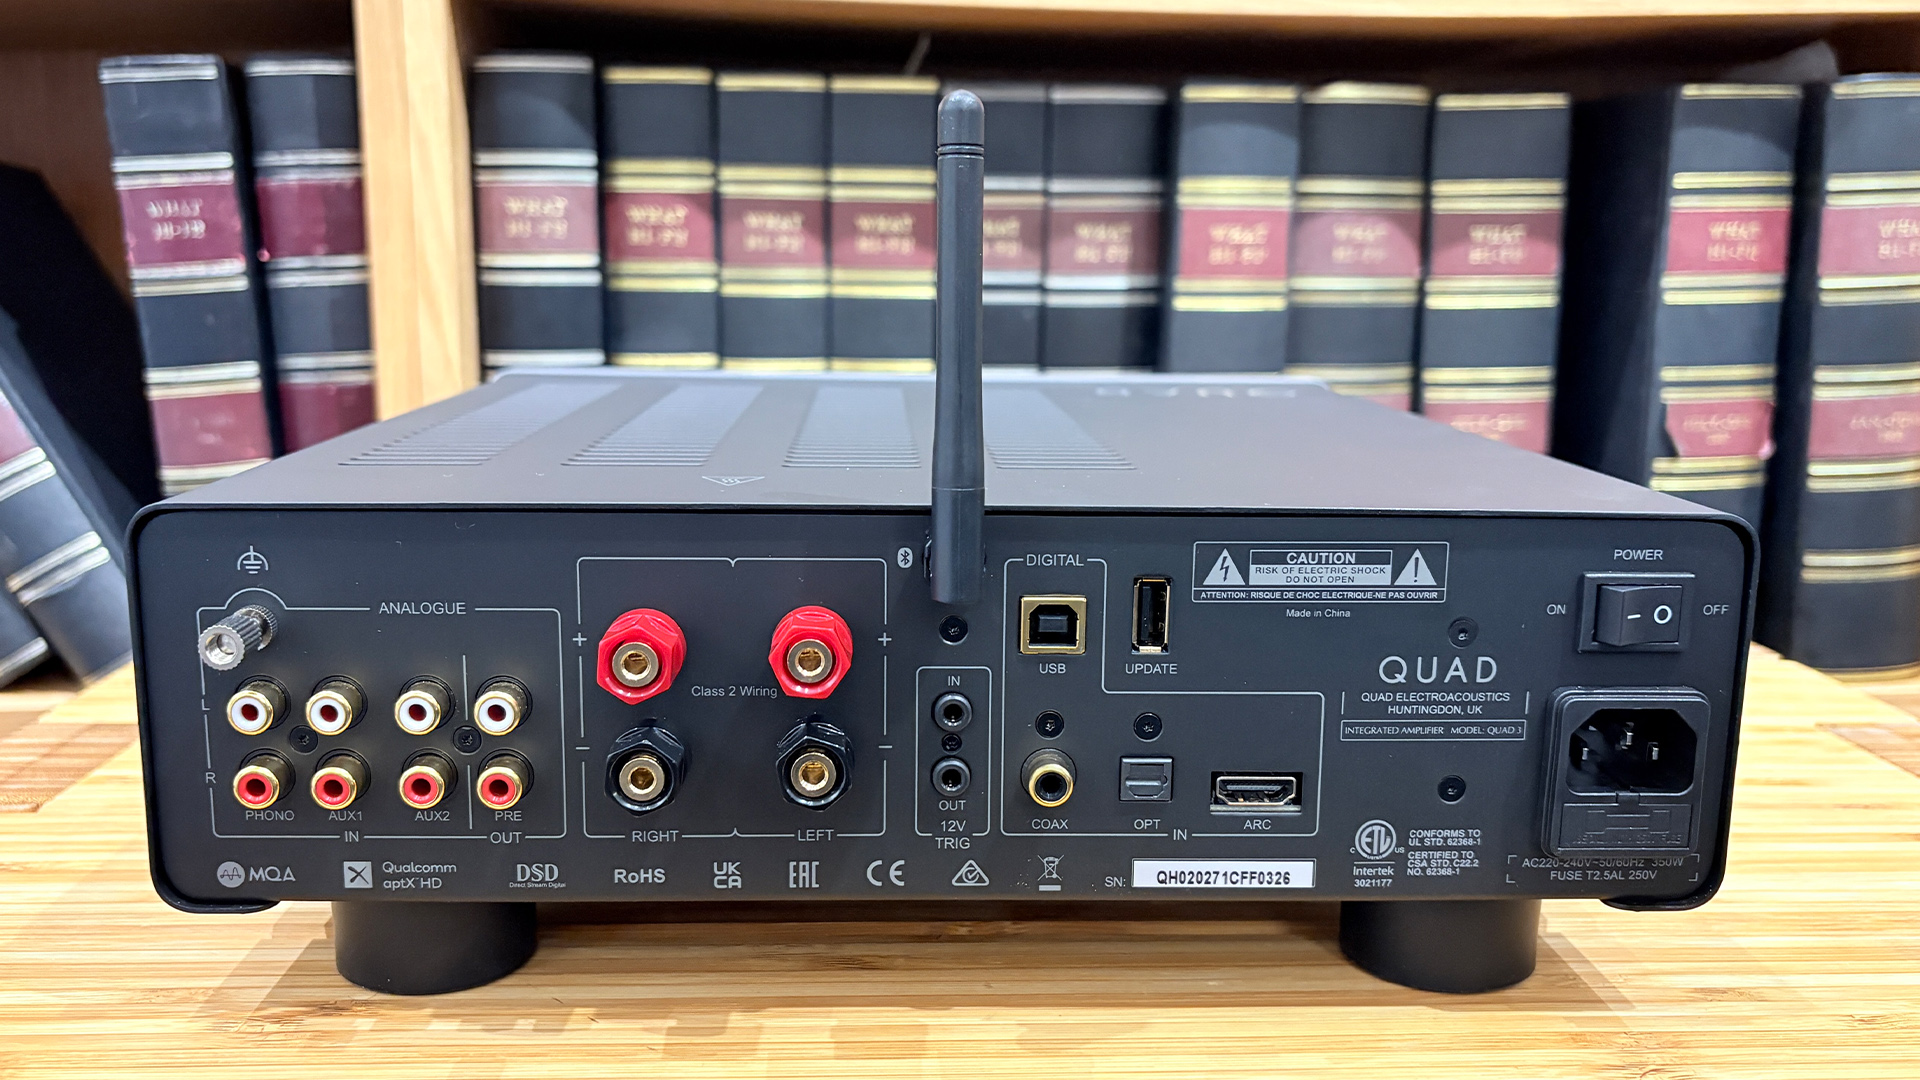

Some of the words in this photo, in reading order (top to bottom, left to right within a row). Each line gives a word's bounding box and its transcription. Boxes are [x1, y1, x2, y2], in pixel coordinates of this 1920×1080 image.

[1027, 554, 1084, 566] DIGITAL
[1287, 553, 1355, 564] CAUTION
[1614, 550, 1663, 560] POWER
[1255, 566, 1279, 575] RISK
[1281, 566, 1295, 575] OF
[1297, 566, 1348, 575] ELECTRIC
[1350, 566, 1386, 575] SHOCK
[1285, 575, 1301, 584] DO
[1303, 575, 1324, 584] NOT
[1326, 575, 1355, 584] OPEN
[1200, 591, 1249, 600] ATTENTION:
[1250, 591, 1282, 599] RISQUE
[1282, 591, 1295, 599] DE
[1295, 591, 1321, 599] CHOC
[1321, 591, 1387, 600] ELECTRIQUE-NE
[1388, 591, 1406, 599] PAS
[1406, 591, 1438, 599] OUVRIR
[379, 602, 466, 614] ANALOGUE
[1547, 604, 1565, 614] ON
[1703, 605, 1729, 615] OFF
[1287, 609, 1311, 617] Made
[1313, 610, 1322, 618] in
[1325, 609, 1350, 617] China
[1040, 663, 1066, 673] USB
[1126, 664, 1177, 674] UPDATE
[1379, 656, 1496, 683] QUAD
[948, 676, 960, 686] IN
[692, 686, 724, 696] Class
[729, 686, 735, 696] 2
[740, 686, 777, 698] Wiring
[1362, 693, 1393, 701] QUAD
[1396, 693, 1510, 701] ELECTROACOUSTICS
[202, 699, 210, 710] L
[1388, 705, 1463, 715] HUNTINGDON,
[1467, 706, 1482, 714] UK
[1344, 726, 1400, 735] INTEGRATED
[1400, 726, 1445, 735] AMPLIFIER
[1450, 726, 1485, 735] MODEL:
[1487, 726, 1515, 735] QUAD
[1516, 726, 1522, 735] 3
[206, 772, 216, 783] R
[939, 800, 966, 810] OUT
[246, 810, 294, 820] PHONO
[329, 809, 362, 821] AUX1
[415, 811, 450, 821] AUX2
[495, 809, 522, 821] PRE
[941, 821, 966, 831] 12V
[1032, 819, 1068, 829] COAX
[1134, 819, 1160, 829] OPT
[1244, 820, 1271, 829] ARC
[345, 831, 358, 842] IN
[490, 832, 522, 843] OUT
[632, 831, 679, 842] RIGHT
[798, 830, 834, 841] LEFT
[1174, 829, 1187, 840] IN
[1409, 830, 1467, 839] CONFORMS
[1468, 829, 1480, 839] TO
[935, 836, 970, 850] TRIG
[1409, 838, 1421, 846] UL
[1424, 838, 1445, 846] STD.
[1446, 837, 1481, 846] 62368-1
[1408, 851, 1459, 859] CERTIFIED
[1461, 851, 1475, 860] TO
[1408, 859, 1429, 868] CSA
[1430, 859, 1451, 868] STD.
[1453, 859, 1478, 868] C22.2
[1651, 858, 1684, 867] 350W
[383, 862, 456, 874] Qualcomm
[714, 862, 740, 877] UK
[867, 860, 904, 886] CE
[1353, 866, 1394, 875] Intertek
[1406, 867, 1424, 876] NO.
[1425, 867, 1460, 876] 62368-1
[249, 867, 295, 881] MQA
[517, 864, 558, 883] DSD
[615, 869, 665, 883] RoHS
[1156, 871, 1291, 886] QH020271CFF0326
[1551, 871, 1582, 880] FUSE
[1586, 871, 1624, 880] T2.5AL
[1629, 870, 1657, 879] 250V
[420, 877, 443, 889] HD
[508, 881, 527, 889] Direct
[526, 881, 549, 889] Stream
[547, 881, 567, 889] Digital
[714, 876, 741, 888] CA
[1105, 877, 1125, 887] SN:
[1355, 879, 1392, 887] 3021177
